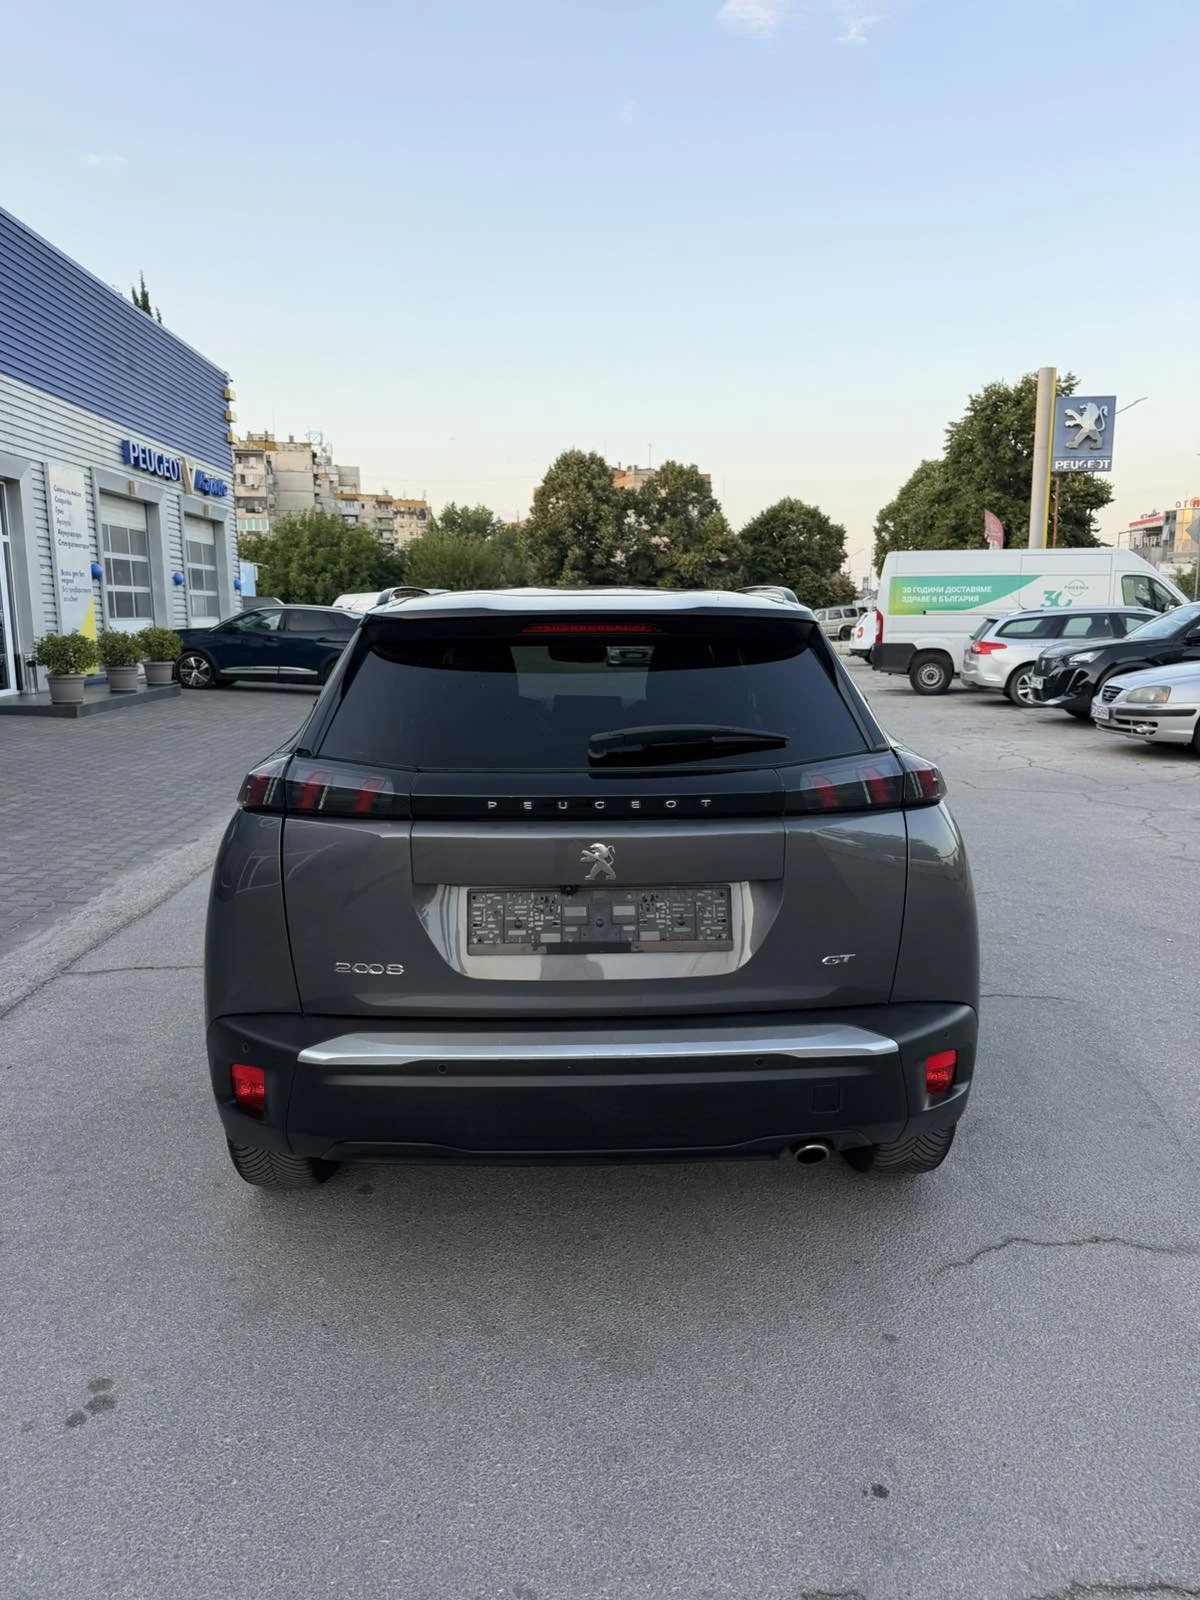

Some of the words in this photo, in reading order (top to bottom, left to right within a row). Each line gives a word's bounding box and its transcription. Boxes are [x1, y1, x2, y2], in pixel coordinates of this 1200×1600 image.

[126, 440, 183, 481] PEUGEOT
[1055, 459, 1111, 470] PEUGEOT
[913, 586, 944, 594] ГОДИНИ
[945, 585, 993, 594] ДОСТАВЯМЕ
[938, 595, 980, 603] БЪЛГАРИЯ
[487, 799, 712, 810] PEUGEOT
[821, 953, 857, 966] GT
[335, 962, 405, 975] 2008
